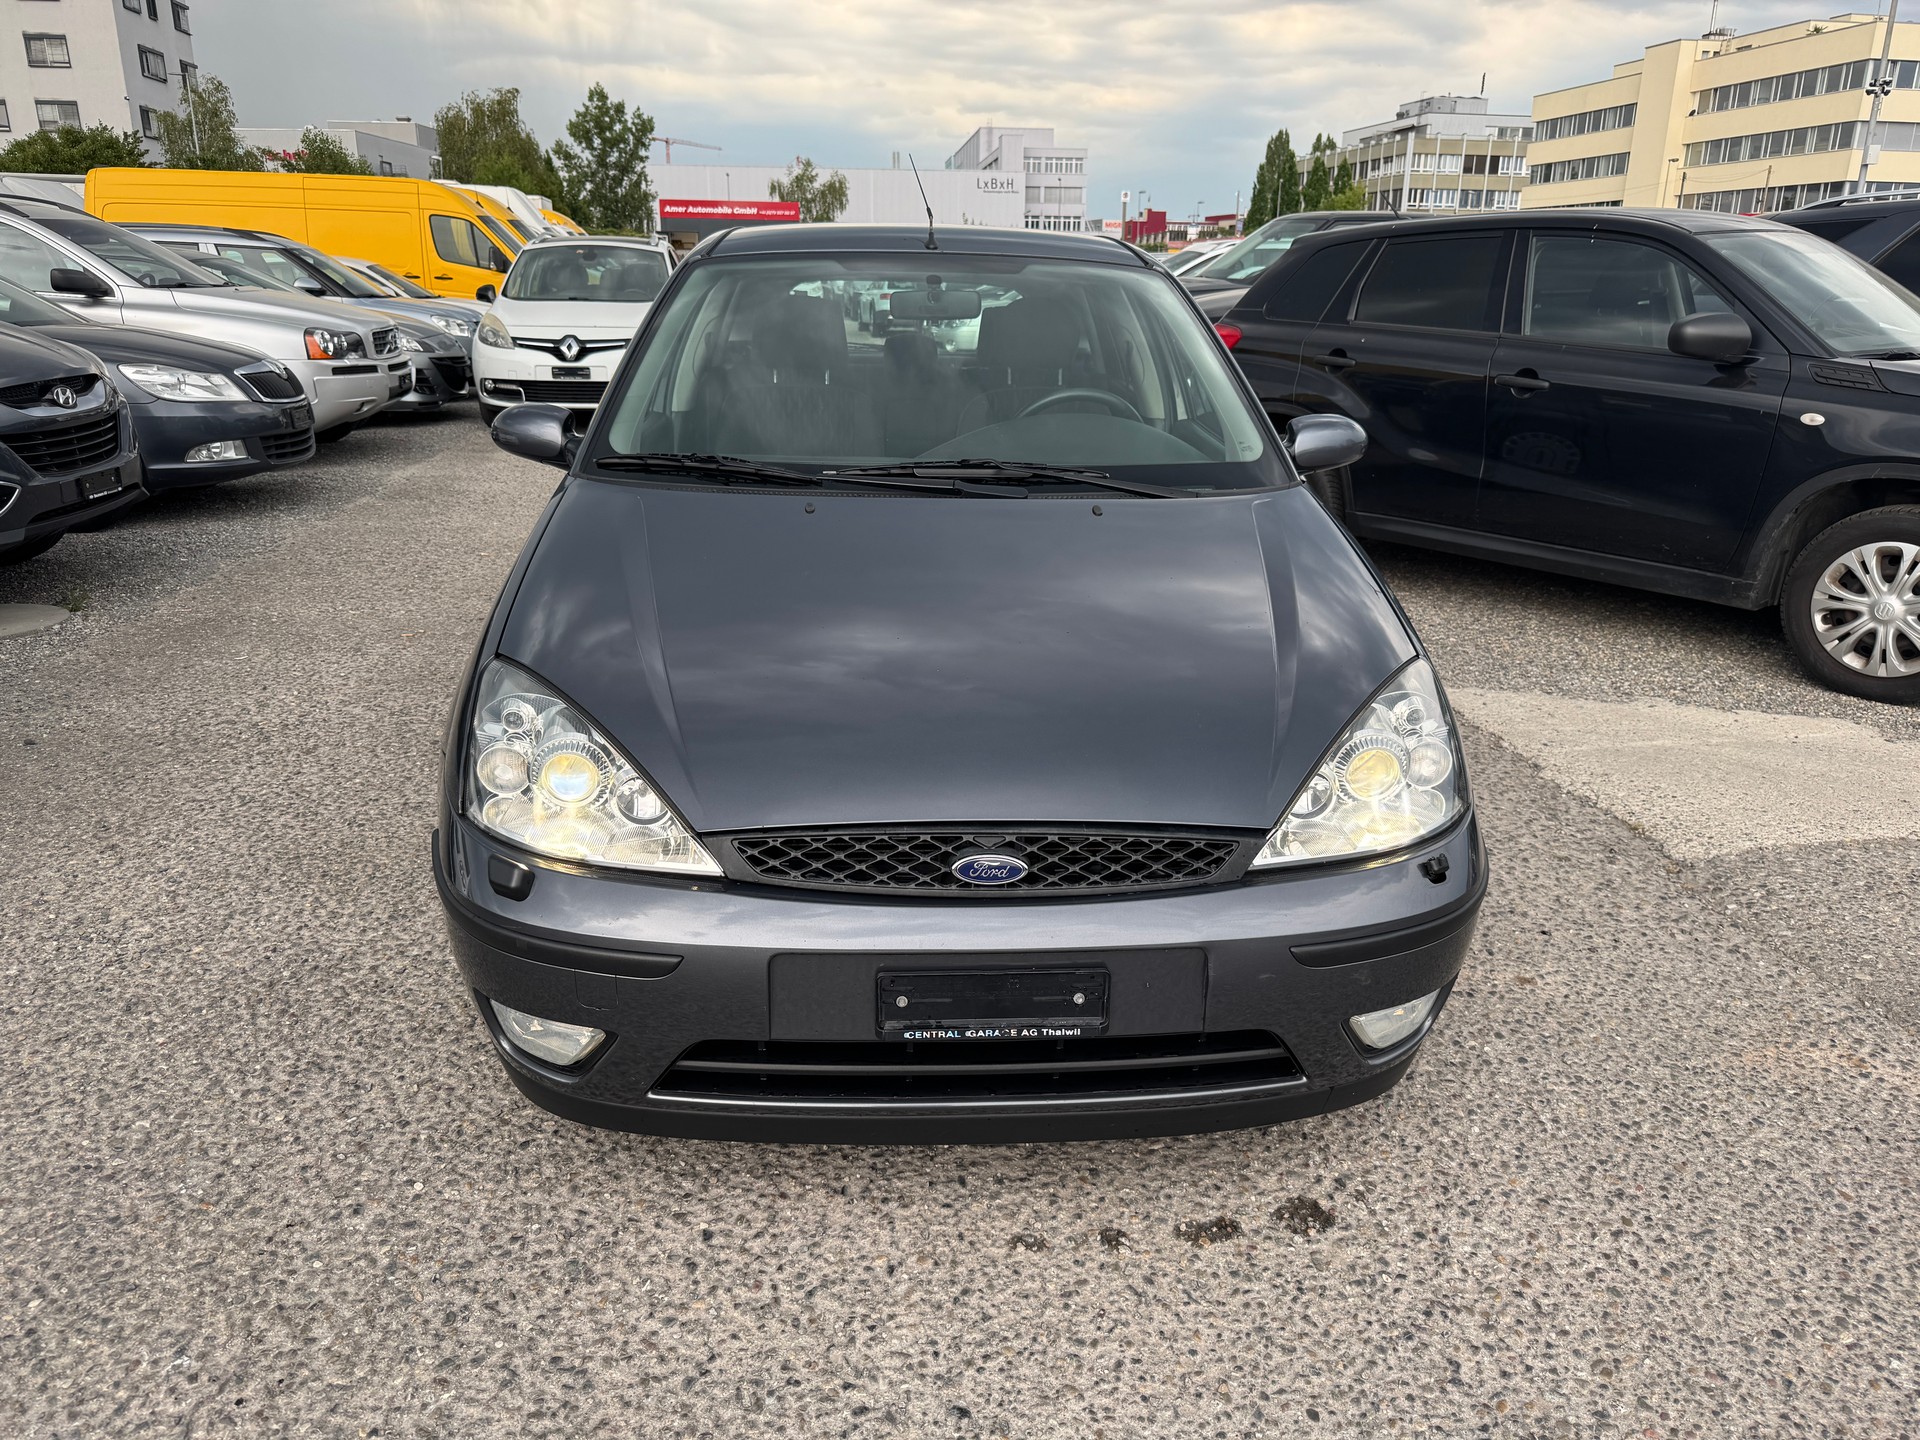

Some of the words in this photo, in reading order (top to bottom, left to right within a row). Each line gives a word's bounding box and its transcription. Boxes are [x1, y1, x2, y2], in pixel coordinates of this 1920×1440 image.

[664, 205, 686, 213] Amer
[687, 205, 732, 214] Automobile
[733, 207, 757, 215] GmbH
[969, 861, 1011, 877] Ford
[904, 1031, 961, 1039] CENTRAL
[1021, 1029, 1038, 1037] AG
[1042, 1028, 1081, 1036] Thalwil
